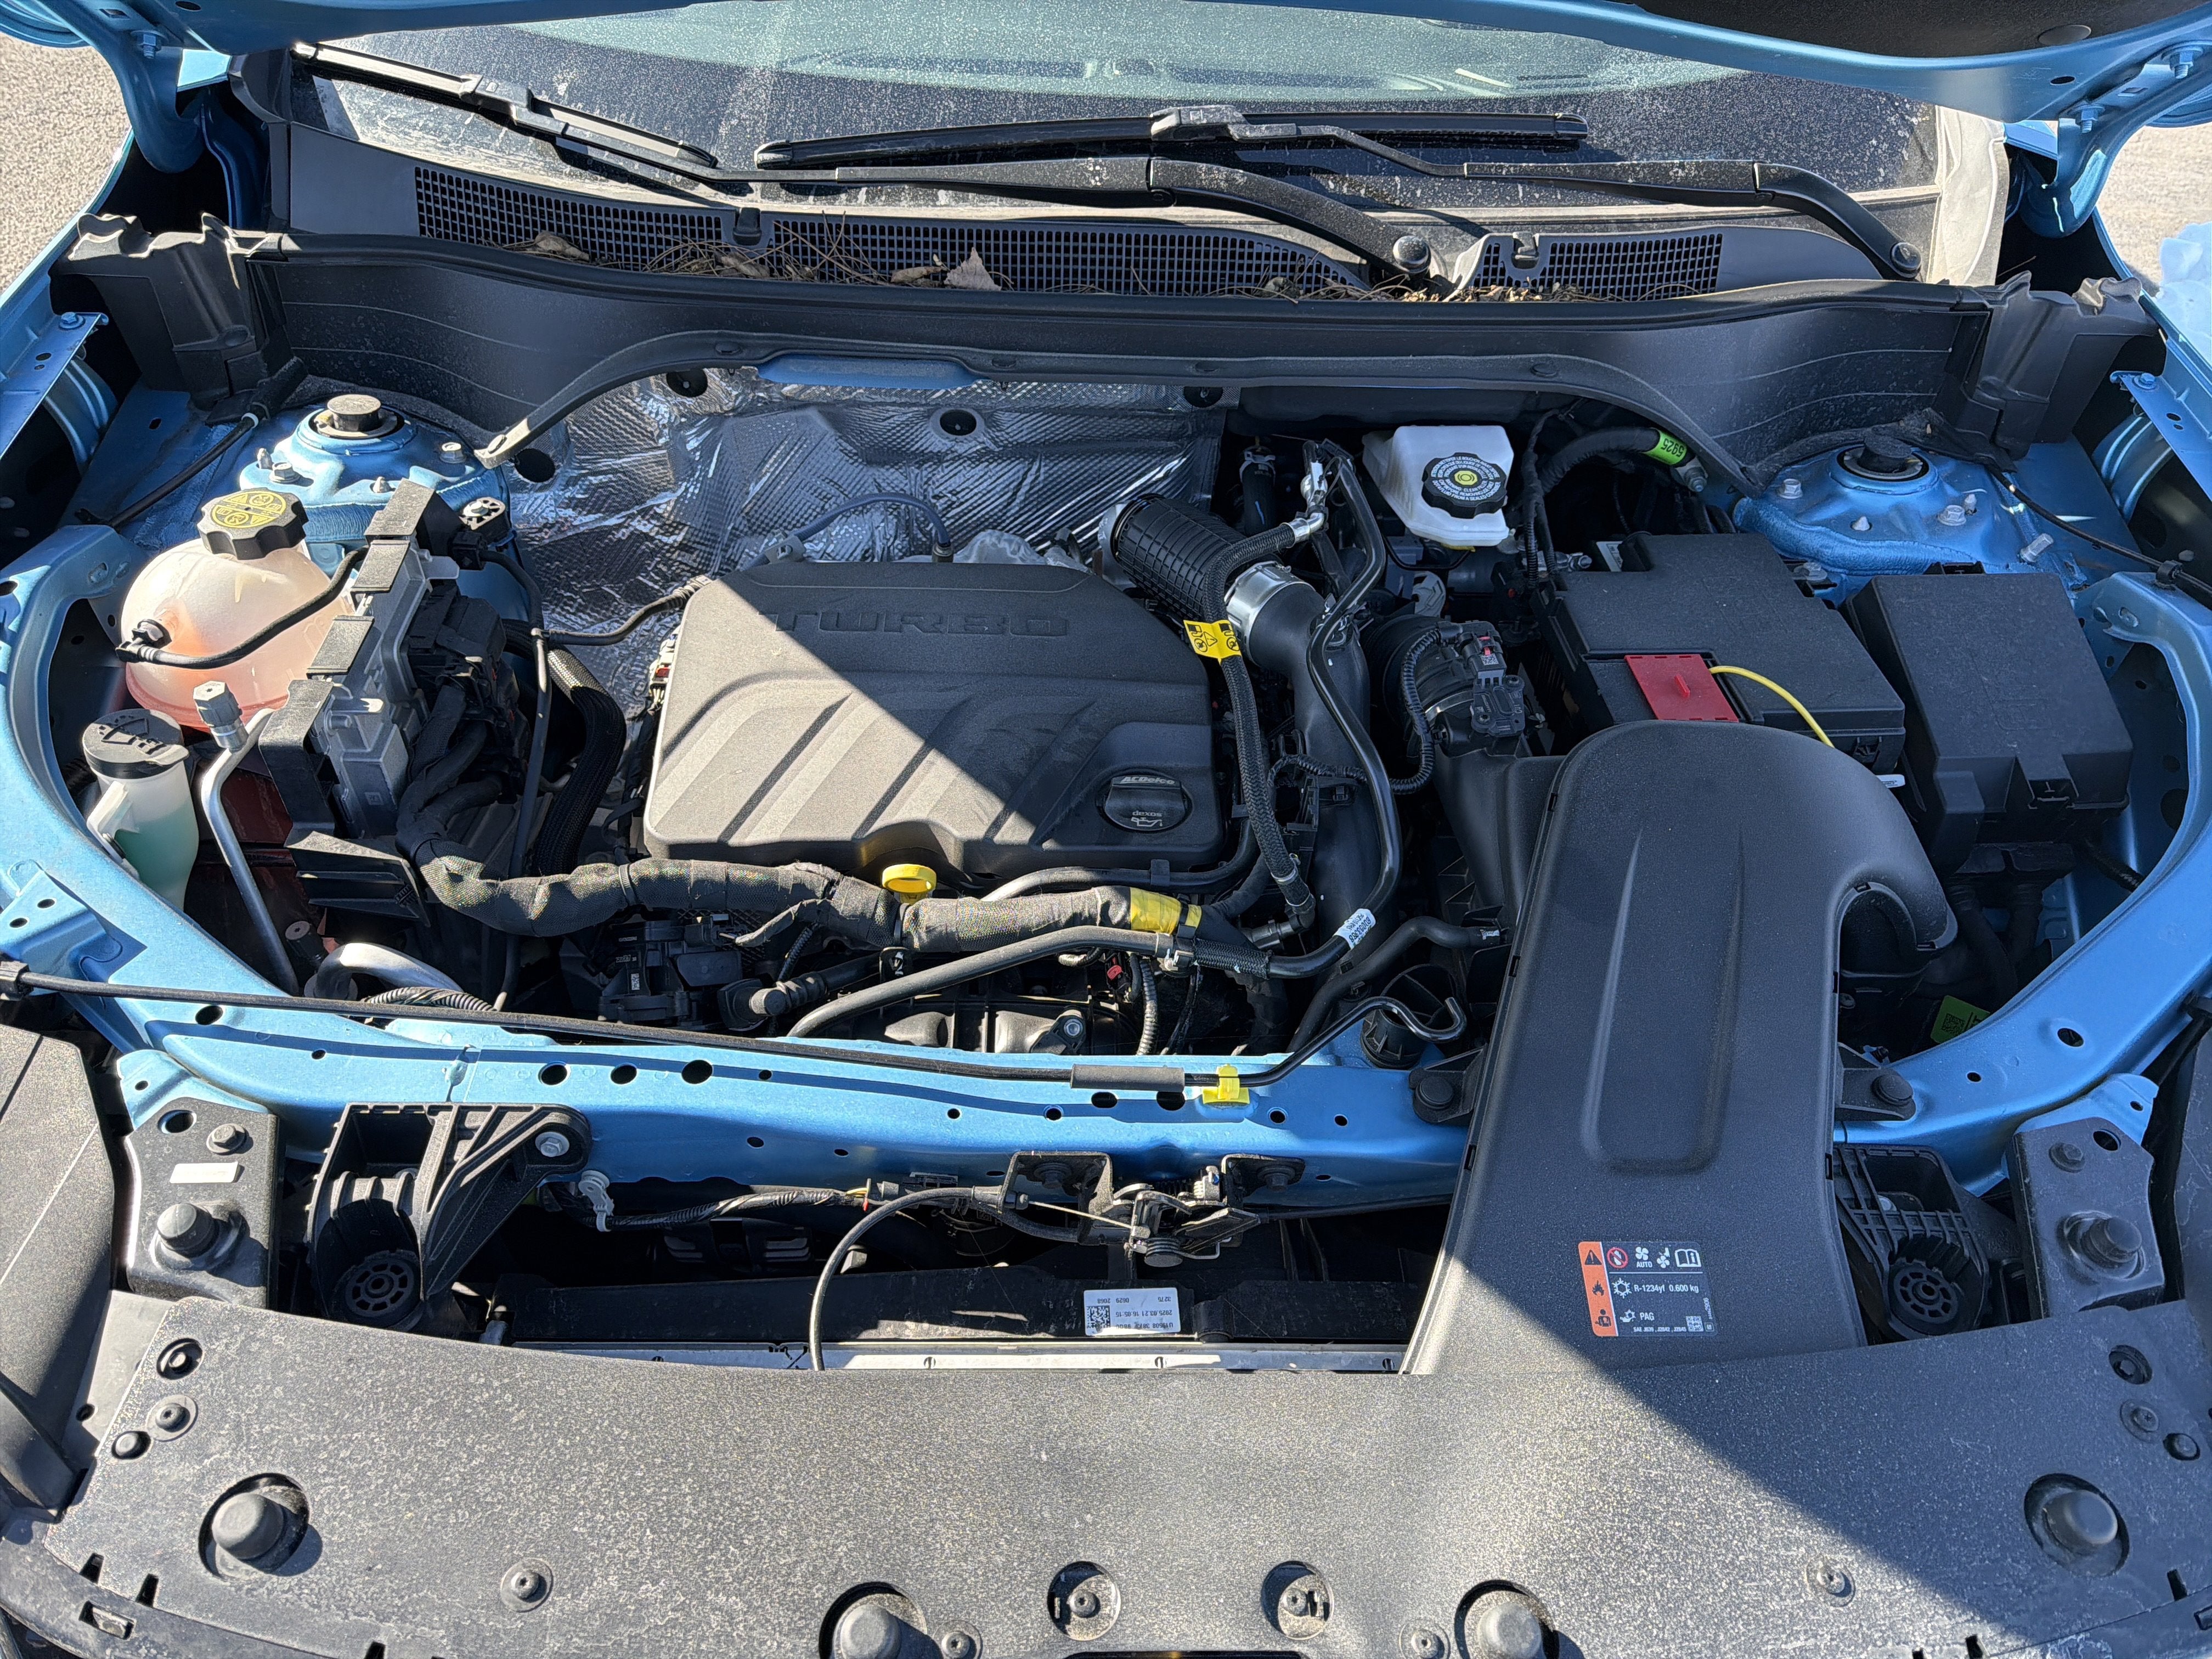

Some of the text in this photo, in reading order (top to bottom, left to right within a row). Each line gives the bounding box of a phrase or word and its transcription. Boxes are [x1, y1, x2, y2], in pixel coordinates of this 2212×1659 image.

[1661, 438, 1684, 457] 5925
[758, 611, 1069, 637] TURBO
[1121, 776, 1175, 785] ACDelco
[1634, 1284, 1665, 1294] R-1234yf
[1690, 1284, 1699, 1294] kg
[1639, 1312, 1655, 1321] PAG
